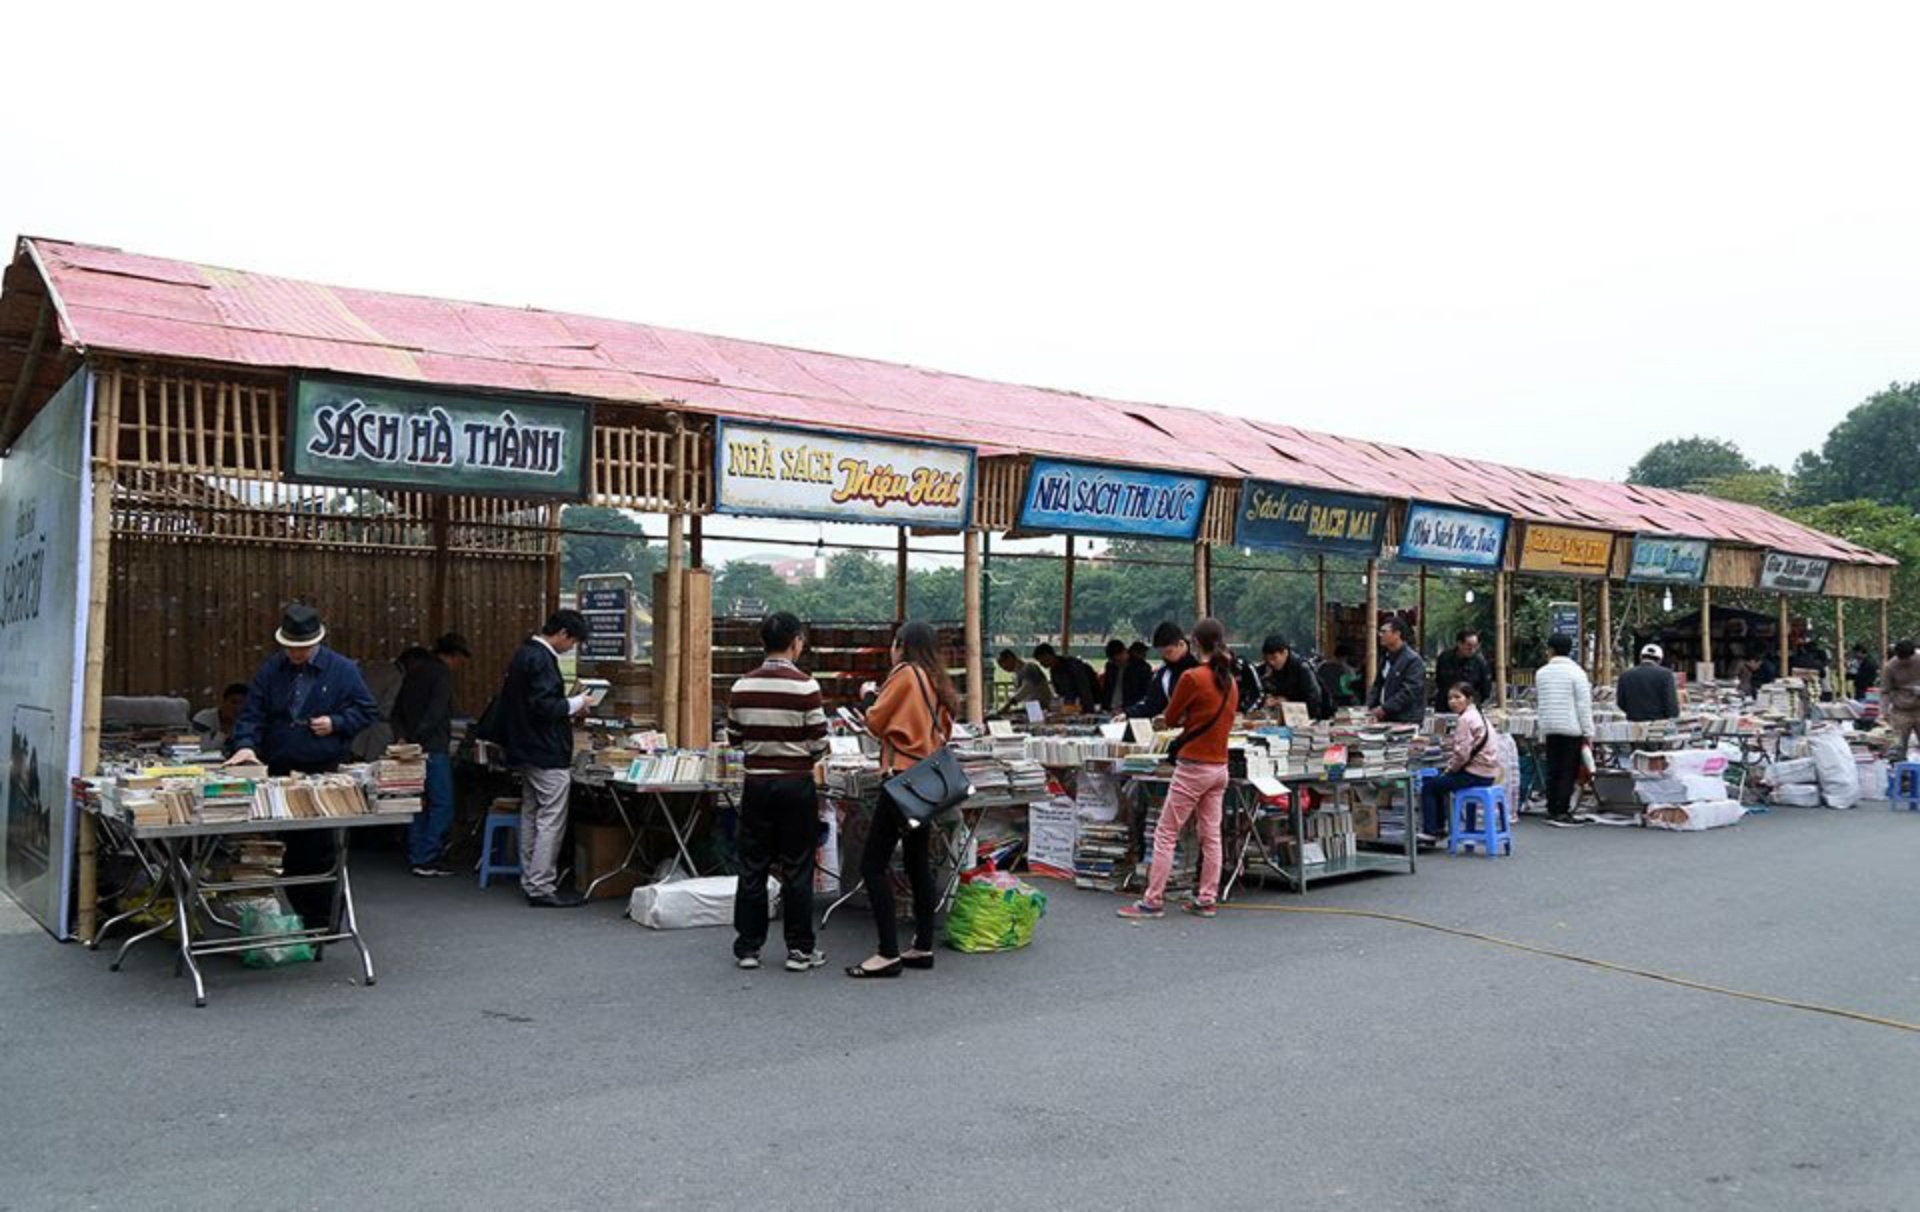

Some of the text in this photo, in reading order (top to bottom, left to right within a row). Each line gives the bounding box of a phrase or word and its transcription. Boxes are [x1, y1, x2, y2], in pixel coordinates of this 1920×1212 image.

[309, 400, 562, 474] SÁCH HÀ THÀNH
[728, 440, 776, 479] NHÀ
[781, 446, 833, 484] SÁCH
[1033, 471, 1071, 512] NHÀ
[1072, 475, 1123, 516] SÁCH
[1246, 490, 1287, 521] Sách
